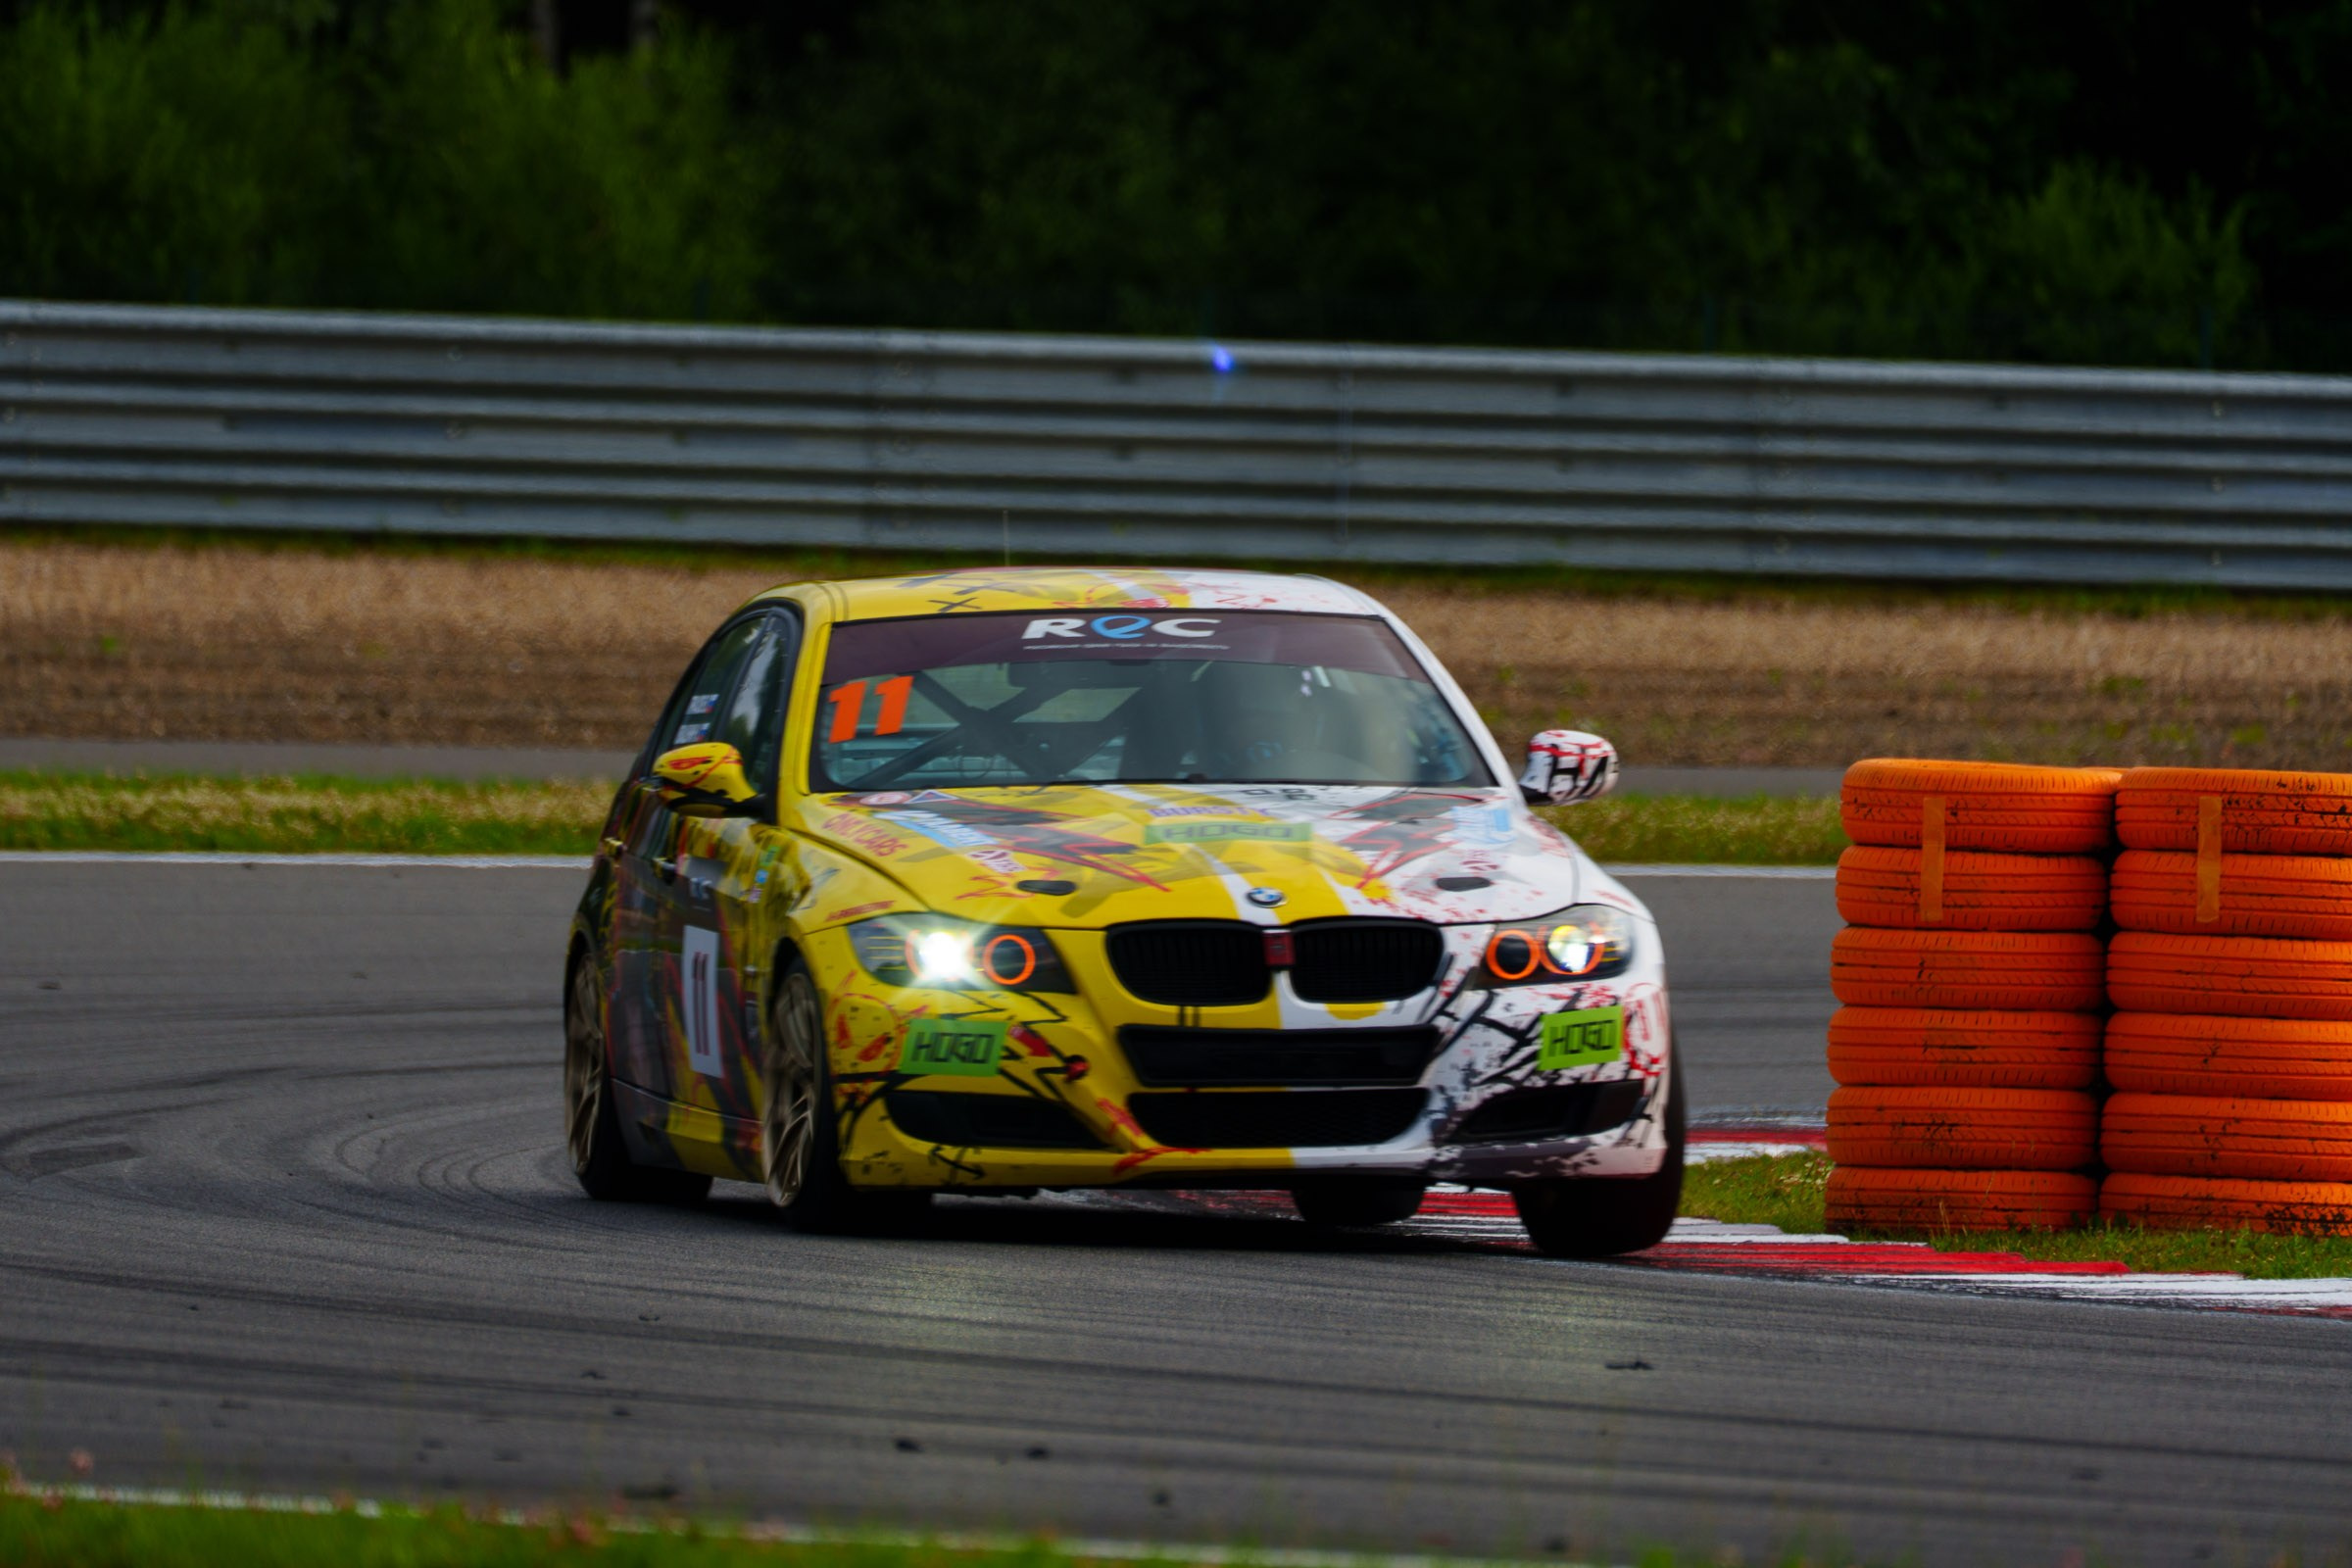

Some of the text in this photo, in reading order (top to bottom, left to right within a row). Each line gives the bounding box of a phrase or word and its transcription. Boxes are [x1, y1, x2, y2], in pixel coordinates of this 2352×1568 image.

[828, 675, 914, 744] 11
[692, 951, 710, 1056] 11
[910, 1031, 997, 1064] HOGO
[1547, 1019, 1616, 1057] HOGO
